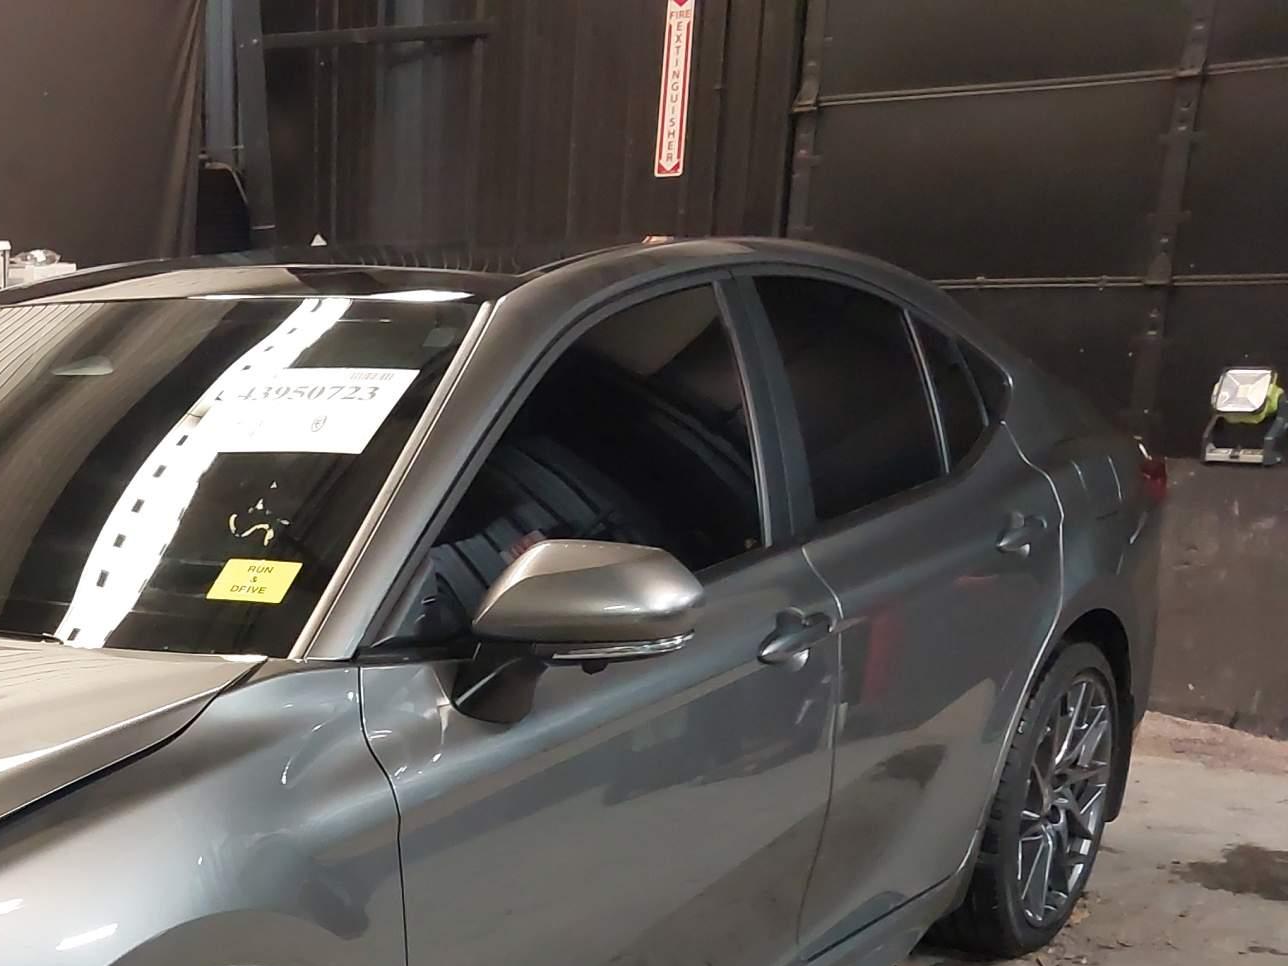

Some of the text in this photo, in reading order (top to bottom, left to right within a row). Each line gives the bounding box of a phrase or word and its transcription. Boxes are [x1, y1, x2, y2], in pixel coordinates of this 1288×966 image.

[669, 10, 692, 19] FIRE
[665, 21, 684, 162] EXTINGUISHER
[237, 385, 381, 401] 43950723
[247, 565, 275, 574] RUN
